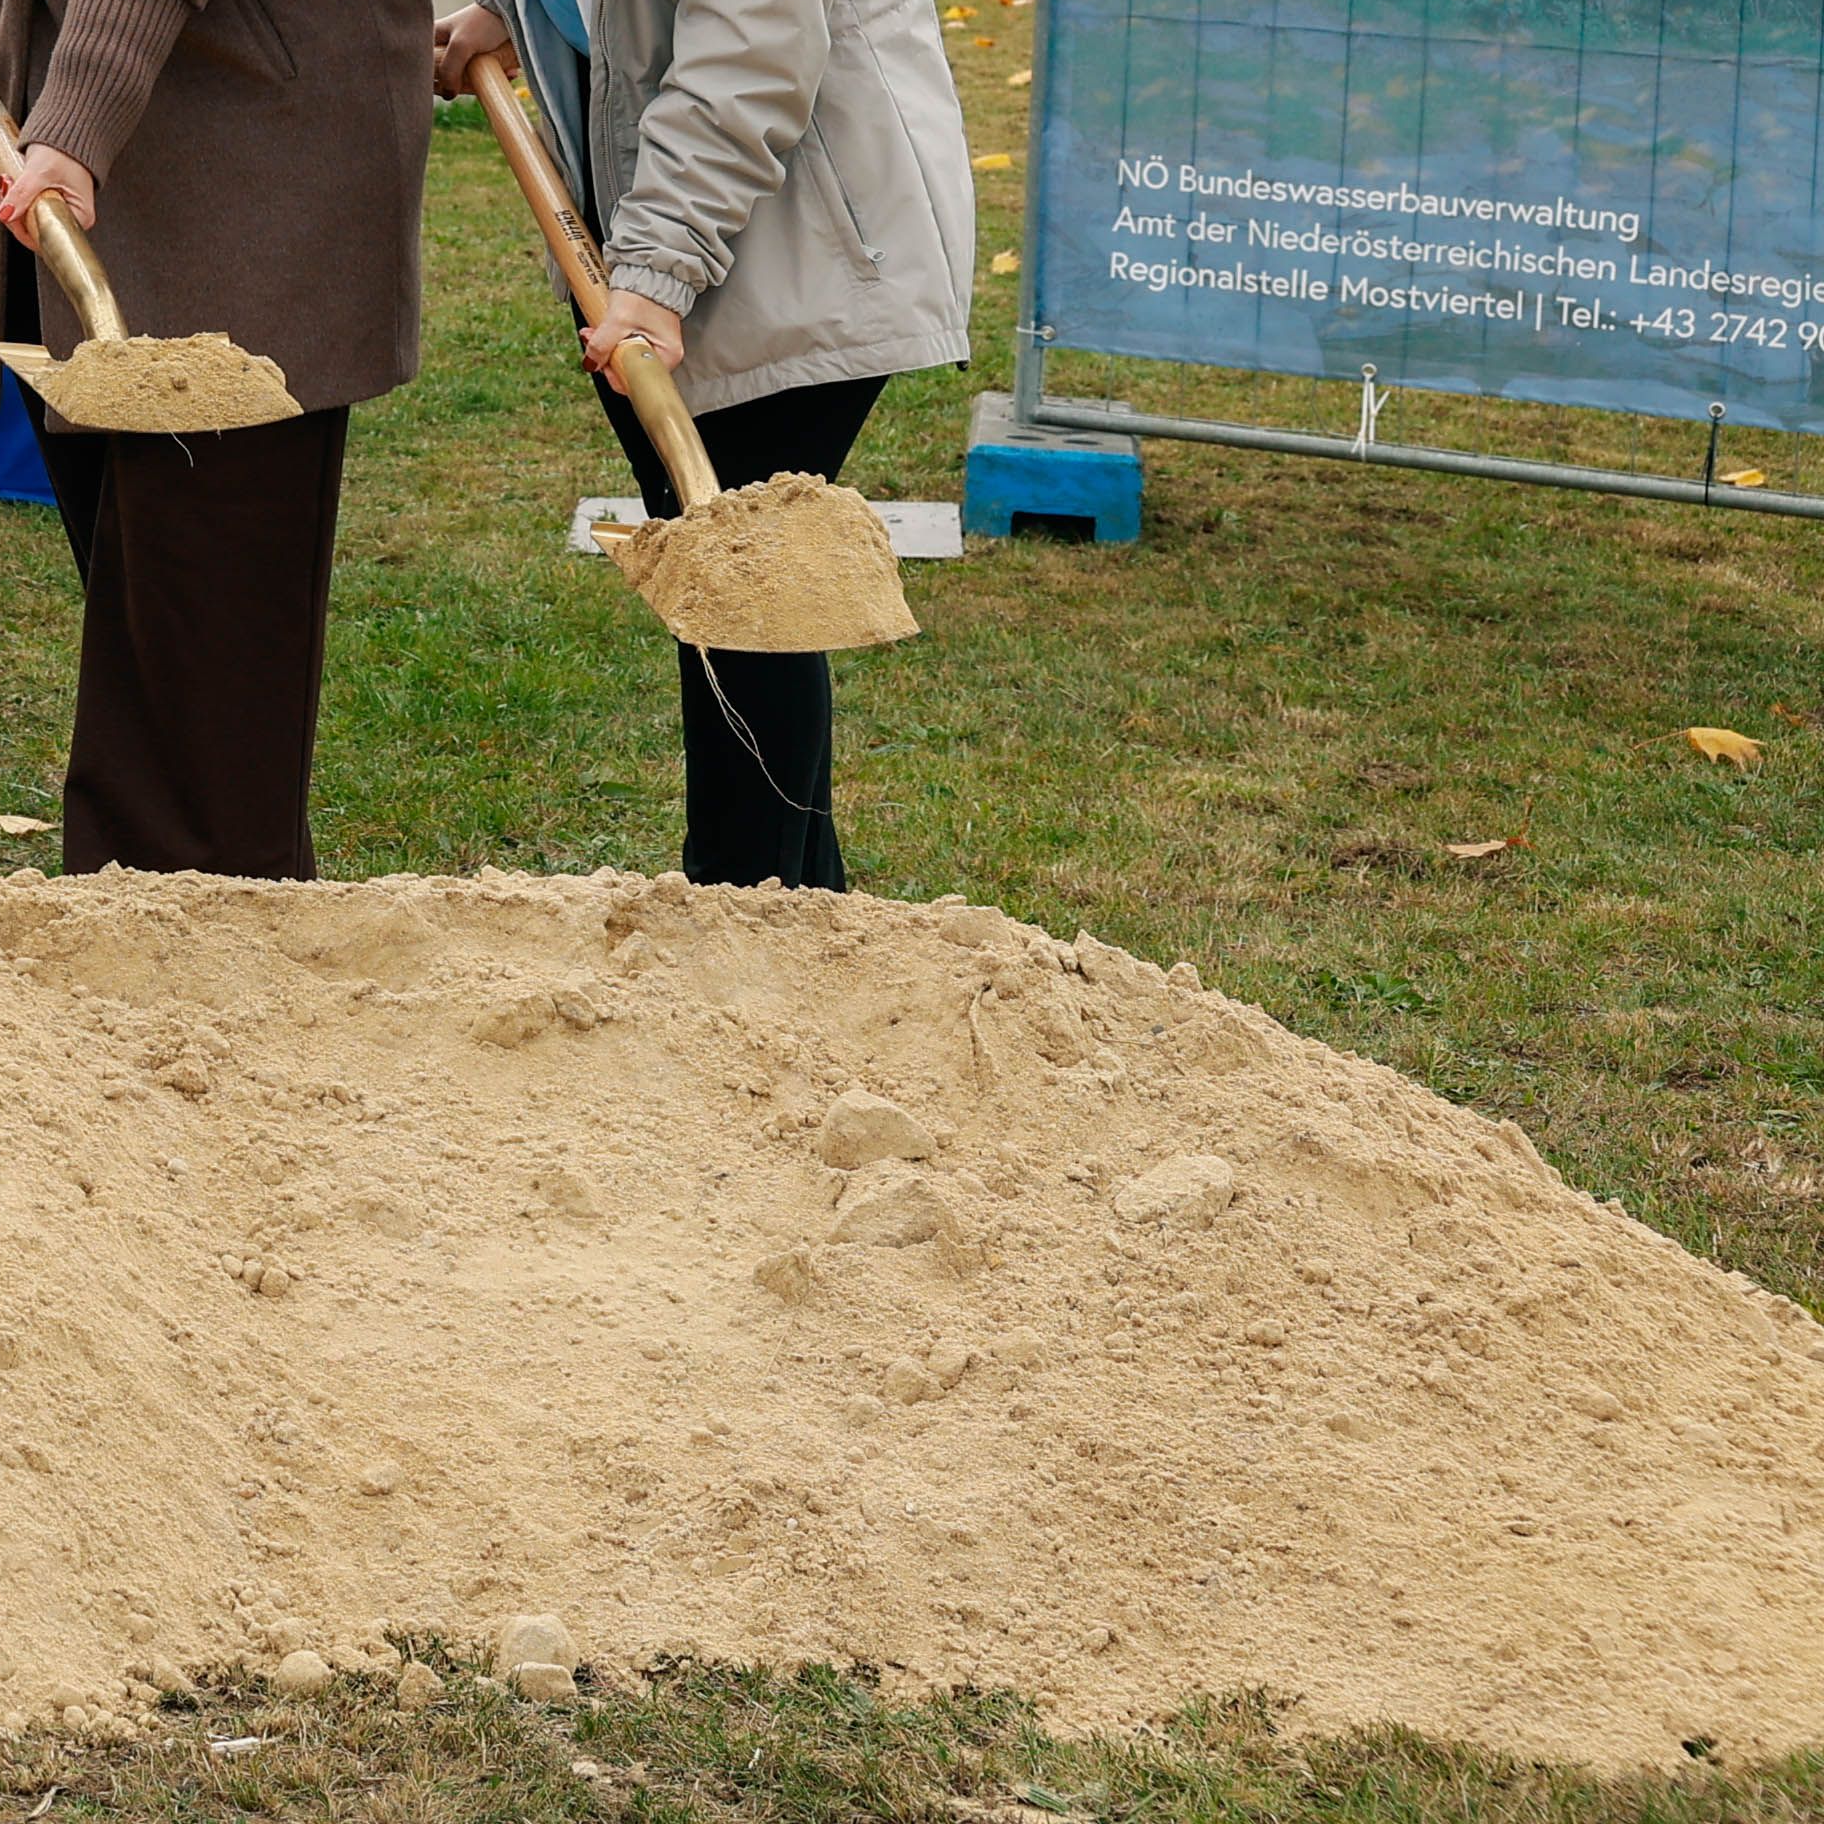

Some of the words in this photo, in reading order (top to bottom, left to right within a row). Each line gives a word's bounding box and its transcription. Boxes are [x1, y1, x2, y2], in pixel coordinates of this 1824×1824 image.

[1117, 155, 1170, 190] NÖ
[1179, 164, 1640, 242] Bundeswasserbauverwaltung
[1112, 205, 1177, 239] Amt
[1186, 211, 1237, 243] der
[1248, 218, 1616, 281] Niederösterreichischen
[1110, 251, 1329, 301] Regionalstelle
[1341, 275, 1523, 320] Mostviertel
[1556, 296, 1616, 331] Tel.:
[1630, 307, 1695, 338] +43
[1709, 312, 1788, 349] 2742
